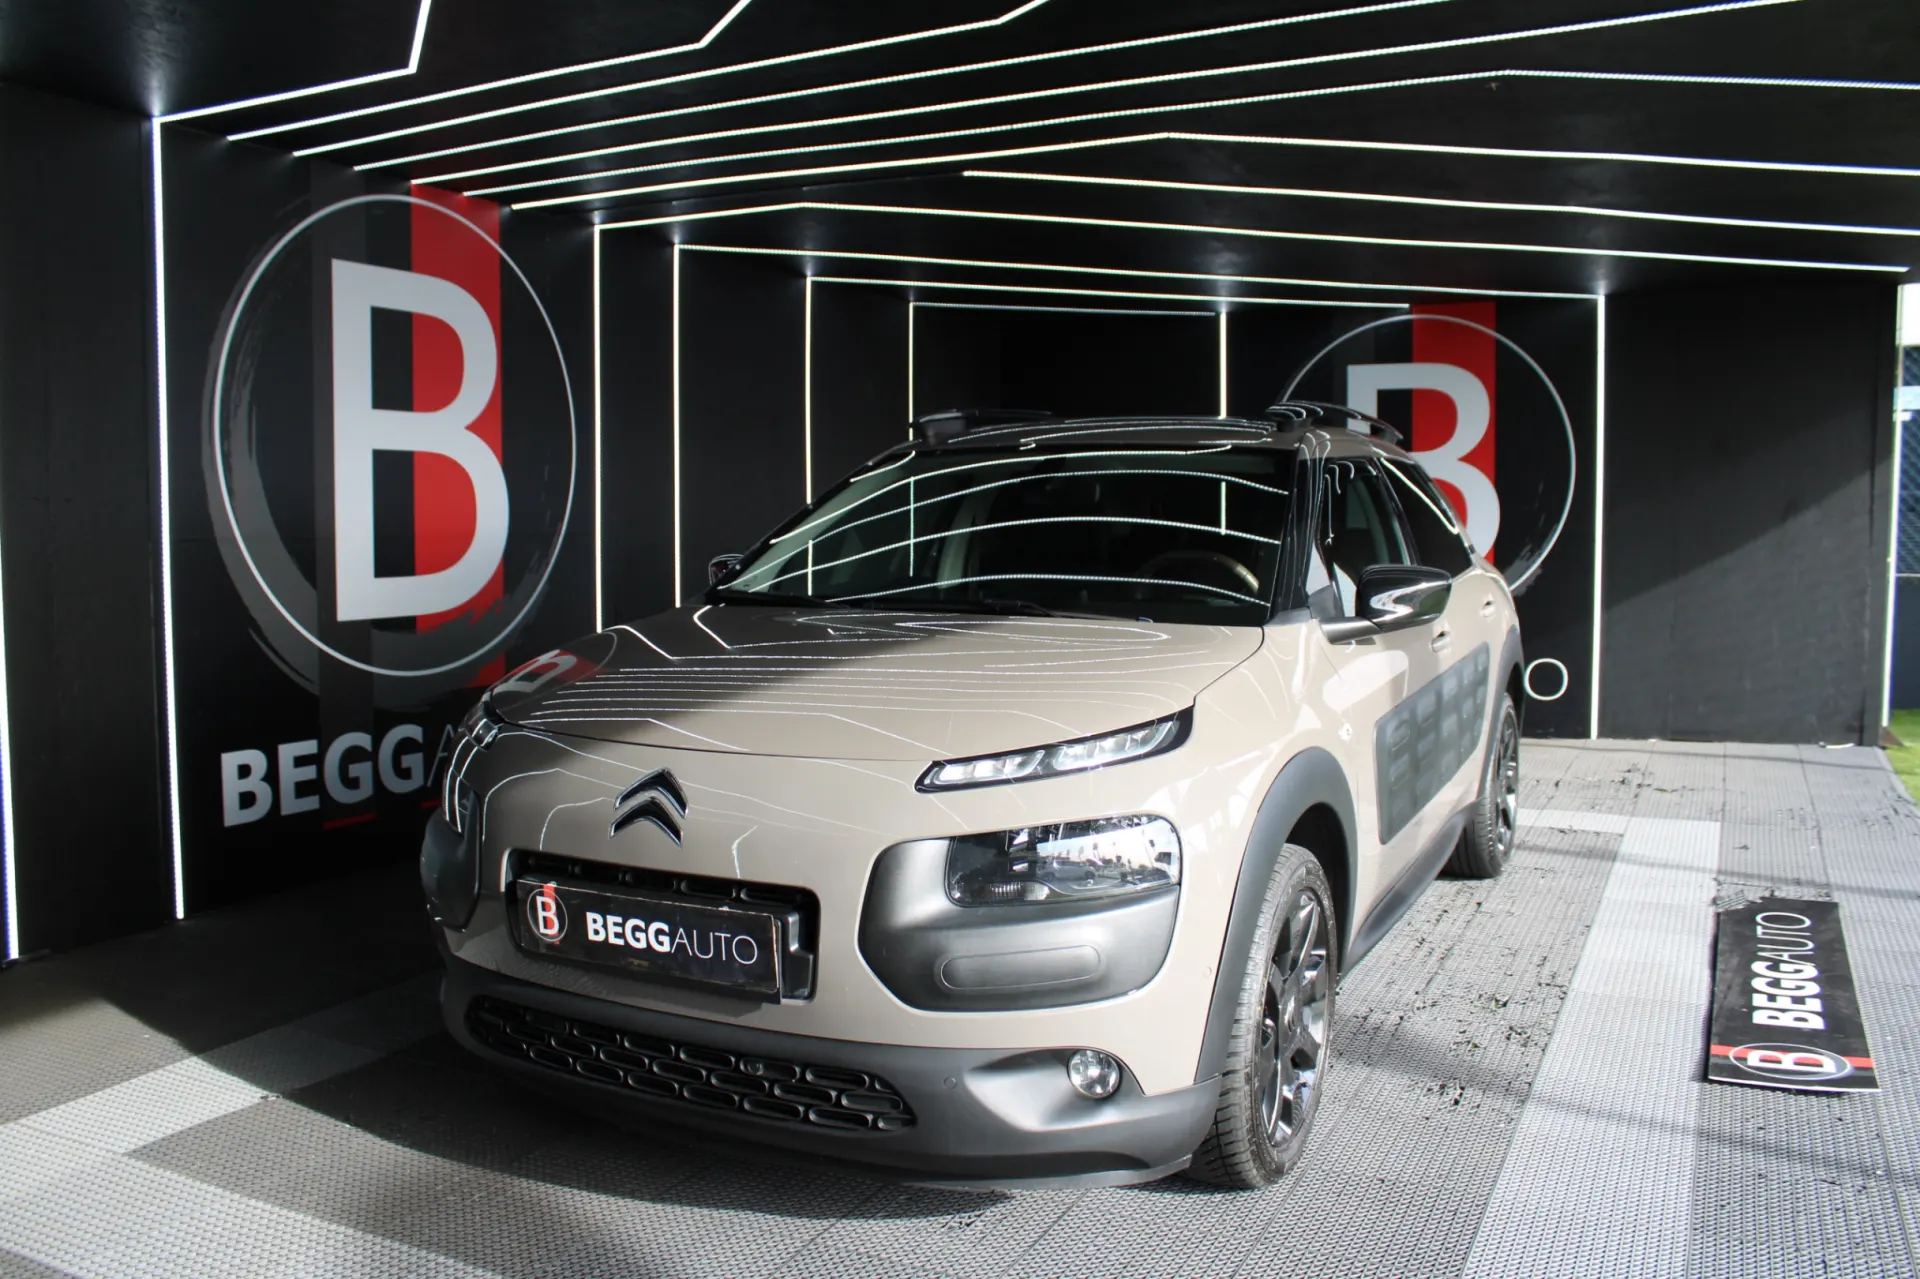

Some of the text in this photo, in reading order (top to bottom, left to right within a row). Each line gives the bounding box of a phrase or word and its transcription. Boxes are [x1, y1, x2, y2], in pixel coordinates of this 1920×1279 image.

[331, 258, 509, 622] B
[221, 723, 455, 828] BEGGA
[535, 895, 758, 965] B BEGGAUTO
[1747, 911, 1838, 1074] B BEGGAUTO
